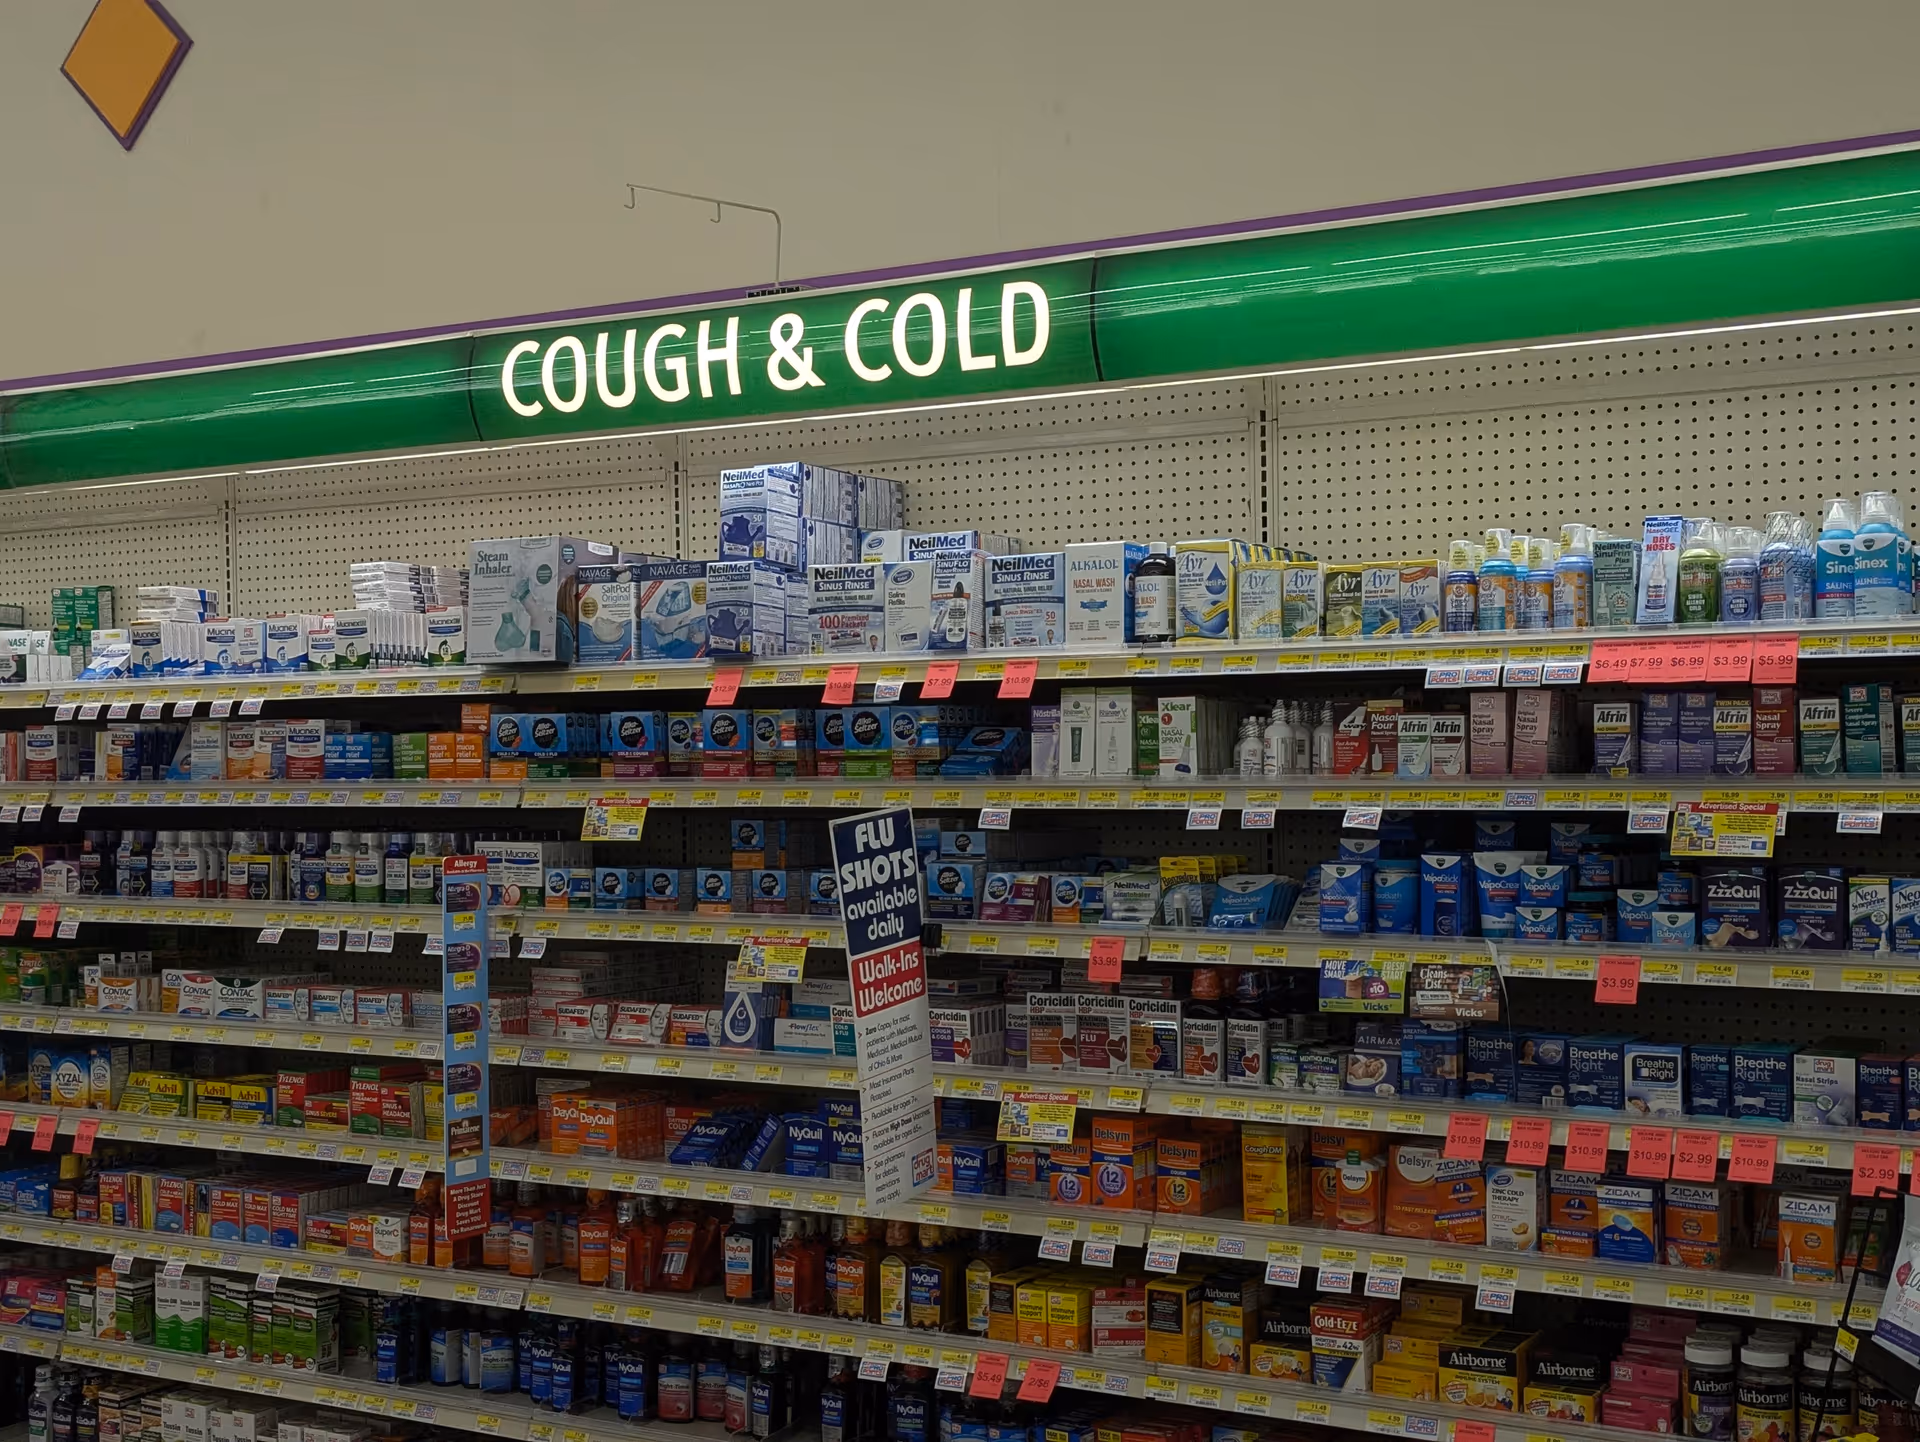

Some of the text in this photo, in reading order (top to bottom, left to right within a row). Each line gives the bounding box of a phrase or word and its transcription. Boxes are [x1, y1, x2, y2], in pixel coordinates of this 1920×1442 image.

[501, 281, 1049, 416] COUGH & COLD
[722, 470, 764, 482] NeilMed
[909, 534, 967, 549] NeilMed
[1652, 534, 1670, 544] DRY
[1647, 543, 1675, 551] NOSES
[477, 550, 508, 563] Steam
[936, 552, 971, 560] NeilMed
[1594, 550, 1632, 558] SinuFrin
[474, 563, 512, 575] Inhaler
[708, 563, 750, 574] NeilMed
[991, 556, 1055, 571] NeilMed
[1071, 559, 1119, 571] ALKALOL
[1854, 557, 1889, 570] Sinex
[579, 569, 611, 578] NAVAGE
[650, 565, 688, 576] NAVAGE
[814, 566, 875, 581] NeilMed
[997, 572, 1050, 582] SINUS RINSE
[1332, 572, 1361, 590] Ayr
[601, 584, 630, 593] SaltPod
[818, 580, 872, 590] SINUS RINSE
[1073, 578, 1115, 588] NASAL WASH
[601, 593, 630, 602] Original
[818, 614, 869, 628] 100 Premixed
[841, 620, 866, 628] Packets
[268, 624, 298, 633] Mucinex
[132, 630, 160, 639] Mucinex
[1594, 658, 1627, 669] $6.49
[1630, 656, 1662, 667] $7.99
[1670, 656, 1704, 667] $6.99
[1713, 655, 1748, 666] $3.99
[1759, 654, 1793, 666] $5.99
[928, 678, 951, 687] $7.99
[1005, 676, 1030, 684] $10.99
[1161, 702, 1191, 712] Xlear
[1371, 713, 1398, 722] Nasal
[1597, 709, 1627, 723] Afrin
[1716, 710, 1748, 723] Afrin
[1756, 713, 1780, 721] Nasal
[1803, 707, 1836, 720] Afrin
[1371, 721, 1394, 730] Four
[1401, 722, 1428, 733] Afrin
[1433, 722, 1460, 734] Afrin
[1472, 719, 1494, 727] Nasal
[1756, 721, 1781, 730] Spray
[1161, 736, 1182, 744] SPRAY
[855, 817, 894, 853] FLU
[454, 860, 477, 868] Allergy
[841, 848, 915, 893] SHOTS
[1708, 884, 1760, 899] ZzzQuil
[1784, 885, 1837, 900] ZzzQuil
[1855, 890, 1877, 901] Neo
[848, 884, 916, 920] available
[1851, 896, 1886, 912] Synephrine
[868, 915, 904, 940] daily
[859, 950, 918, 984] Walk-Ins
[1092, 956, 1118, 967] $3.99
[1325, 960, 1347, 970] MOVE
[1383, 962, 1405, 970] FRESH
[1324, 970, 1345, 979] SMART
[1601, 978, 1634, 989] $3.99
[103, 988, 132, 997] CONTAC
[859, 977, 922, 1012] Welcome
[1078, 996, 1124, 1008] Coricidin
[1129, 1000, 1177, 1014] Coricidin
[1363, 1003, 1389, 1011] Vicks
[929, 1010, 967, 1023] Coricidin
[1455, 1007, 1483, 1017] Vicks
[1081, 1034, 1096, 1043] FLU
[1357, 1036, 1400, 1046] AIRMAX
[1467, 1037, 1513, 1050] Breathe
[1468, 1050, 1499, 1061] Right
[1569, 1047, 1619, 1061] Breathe
[1691, 1053, 1727, 1063] Breathe
[1570, 1059, 1603, 1072] Right
[1636, 1058, 1674, 1069] Breathe
[1692, 1062, 1717, 1072] Right
[1735, 1055, 1787, 1070] Breathe
[56, 1072, 83, 1083] XYZAL
[278, 1074, 305, 1084] TYLENOL
[1649, 1068, 1675, 1080] Right
[1816, 1077, 1839, 1085] Strips
[155, 1083, 177, 1094] Advil
[580, 1113, 614, 1126] DayQuil
[789, 1127, 822, 1140] NyQuil
[1094, 1127, 1130, 1142] Delsym
[1450, 1135, 1481, 1145] $10.99
[1512, 1140, 1544, 1150] $10.99
[1571, 1145, 1603, 1156] $10.99
[1633, 1151, 1666, 1162] $10.99
[1679, 1153, 1712, 1165] $2.99
[914, 1155, 930, 1170] drug
[953, 1157, 980, 1168] NyQuil
[1435, 1159, 1475, 1172] ZICAM
[1735, 1157, 1769, 1168] $10.99
[100, 1173, 123, 1184] TYLENOL
[916, 1167, 934, 1180] mart
[1342, 1174, 1366, 1183] Delsym
[1555, 1173, 1597, 1185] ZICAM
[1858, 1169, 1895, 1180] $2.99
[1508, 1189, 1524, 1197] COLD
[1605, 1188, 1641, 1198] ZICAM
[1670, 1187, 1714, 1200] ZICAM
[458, 1201, 479, 1209] Discount
[837, 1264, 864, 1275] DayQuil
[912, 1273, 938, 1285] NyQuil
[1204, 1288, 1240, 1300] Airborne
[1449, 1353, 1506, 1368] Airborne
[977, 1372, 1001, 1383] $5.49
[1738, 1388, 1790, 1405] Airborne
